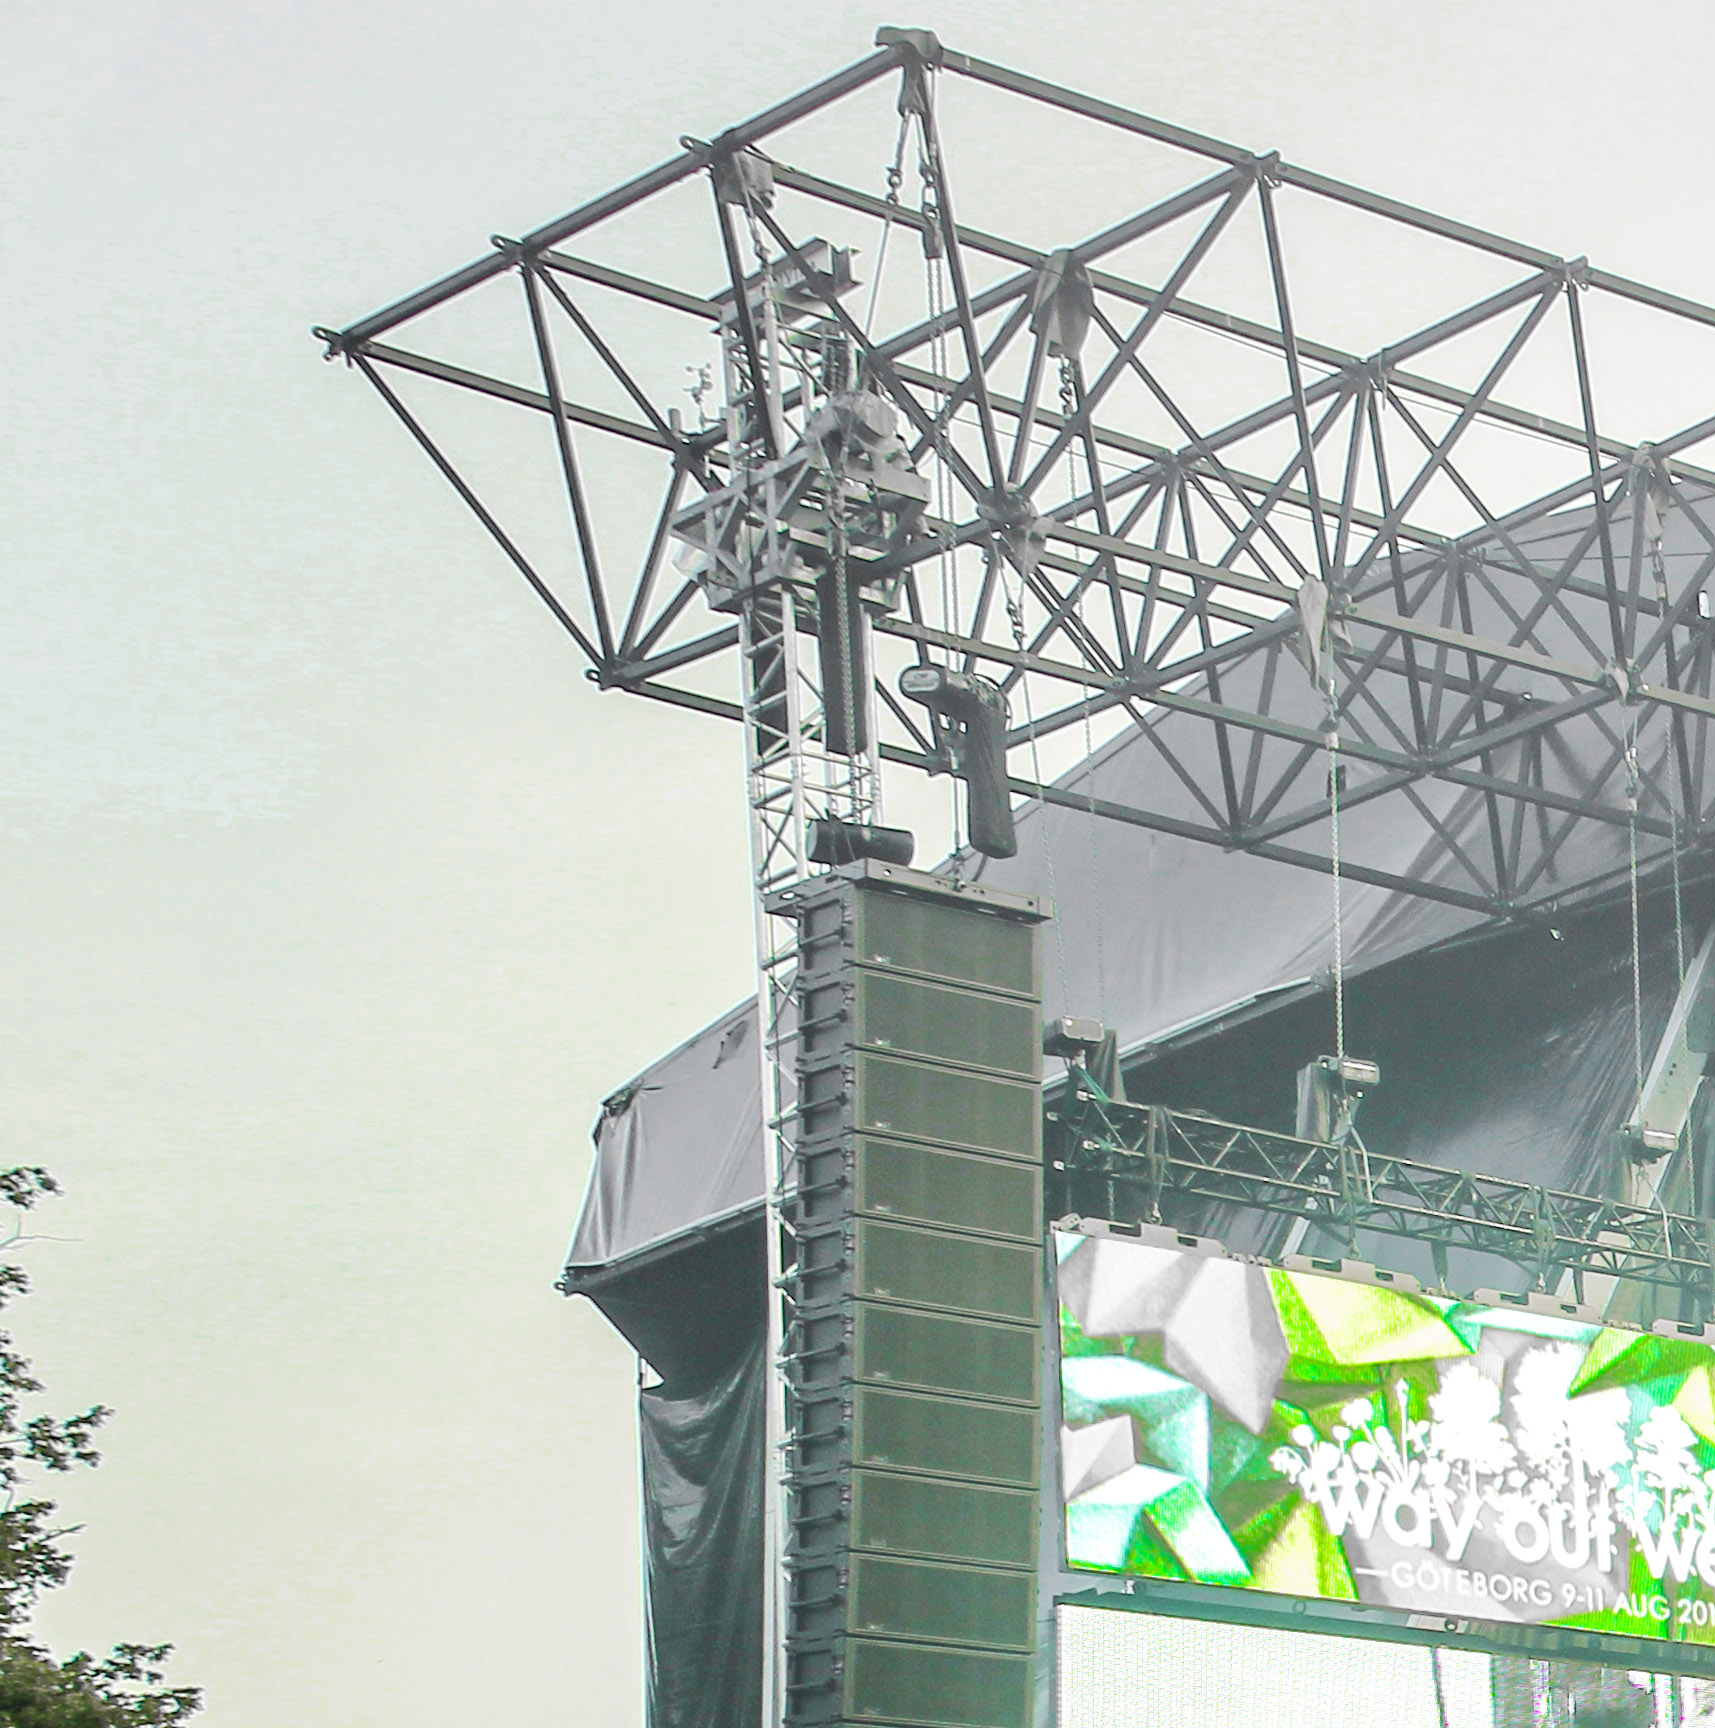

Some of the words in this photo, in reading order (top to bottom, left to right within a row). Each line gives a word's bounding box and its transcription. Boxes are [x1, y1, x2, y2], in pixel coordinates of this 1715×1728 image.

[1309, 1474, 1484, 1562] way
[1501, 1484, 1616, 1574] out
[1391, 1560, 1554, 1607] GÖTEBORG
[1561, 1582, 1605, 1613] 9-11
[1613, 1592, 1671, 1621] AUG
